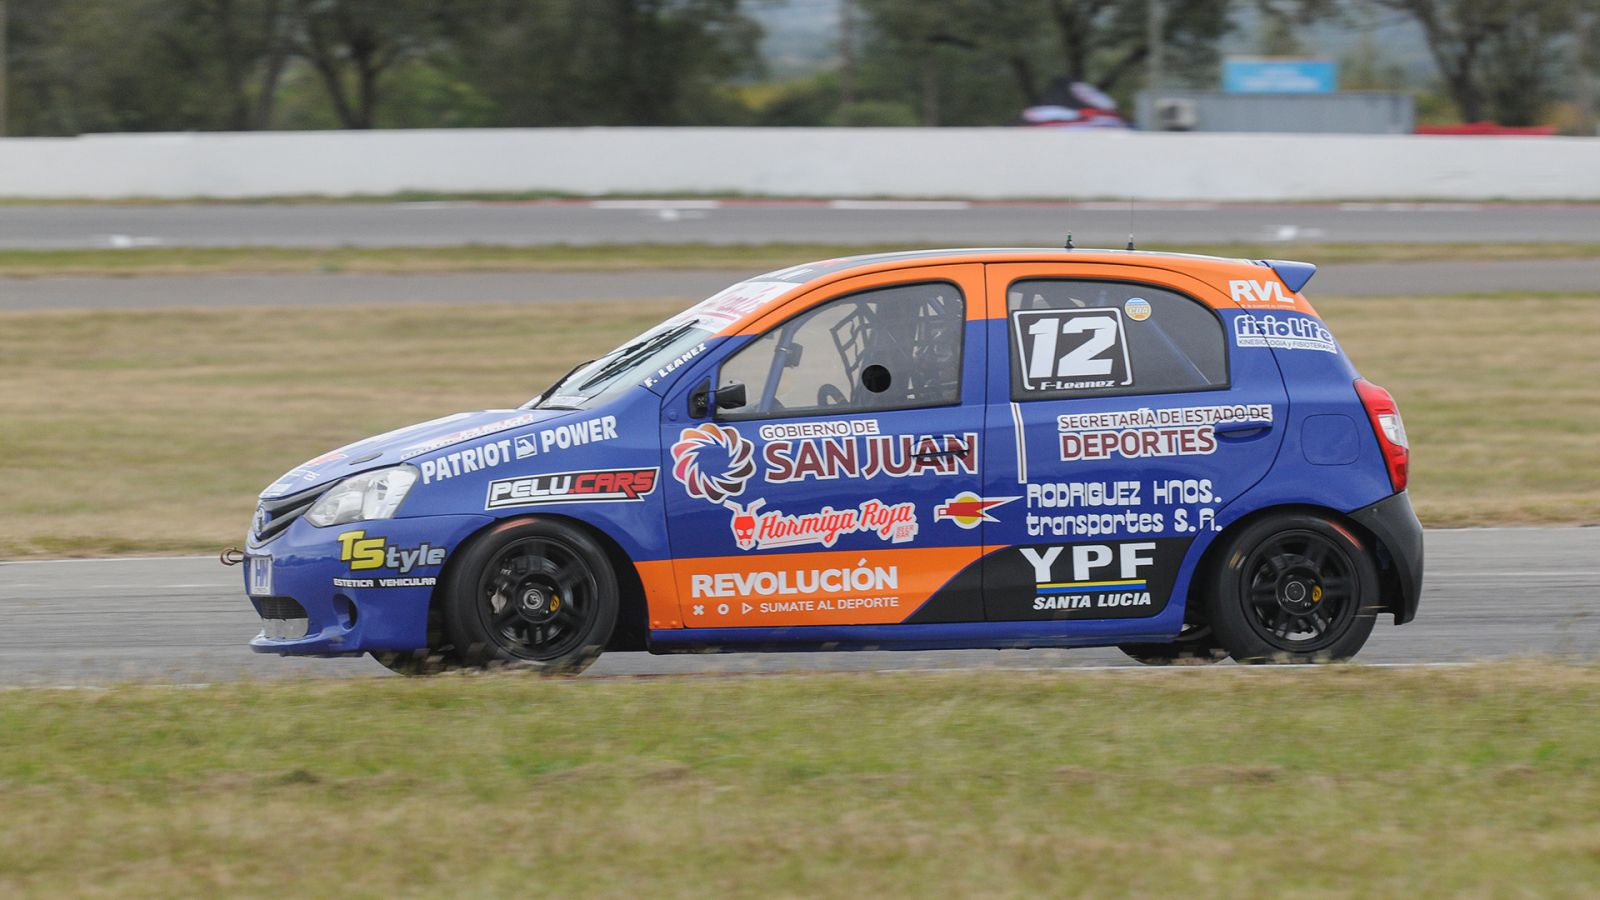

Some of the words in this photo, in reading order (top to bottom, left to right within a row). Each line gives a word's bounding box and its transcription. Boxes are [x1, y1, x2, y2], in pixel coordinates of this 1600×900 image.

[1228, 279, 1294, 304] RVL
[1236, 315, 1333, 341] fisioLife
[1028, 315, 1117, 378] 12
[643, 376, 659, 388] F.
[658, 343, 707, 377] LEANEZ
[1159, 411, 1180, 424] DE
[1186, 407, 1245, 423] ESTADO
[1250, 406, 1270, 420] DE
[762, 422, 848, 439] GOBIERNO
[854, 421, 876, 433] DE
[1062, 428, 1215, 458] DEPORTES
[420, 439, 512, 484] PATRIOT
[541, 415, 619, 453] POWER
[490, 471, 654, 501] PELU.CARS
[1026, 481, 1141, 508] RODRIGUEZ
[758, 508, 852, 543] Hormiga
[860, 502, 912, 535] Roja
[1026, 509, 1164, 537] transportes
[337, 530, 446, 573] TStyle
[1019, 542, 1156, 583] YPF
[333, 578, 374, 588] ESTETICA
[379, 577, 436, 587] VEHICULAR
[691, 557, 898, 598] REVOLUCIÓN
[759, 601, 814, 613] SUMATE
[817, 600, 835, 610] AL
[837, 597, 899, 609] DEPORTE
[1032, 595, 1091, 610] SANTA
[1097, 592, 1151, 607] LUCIA
